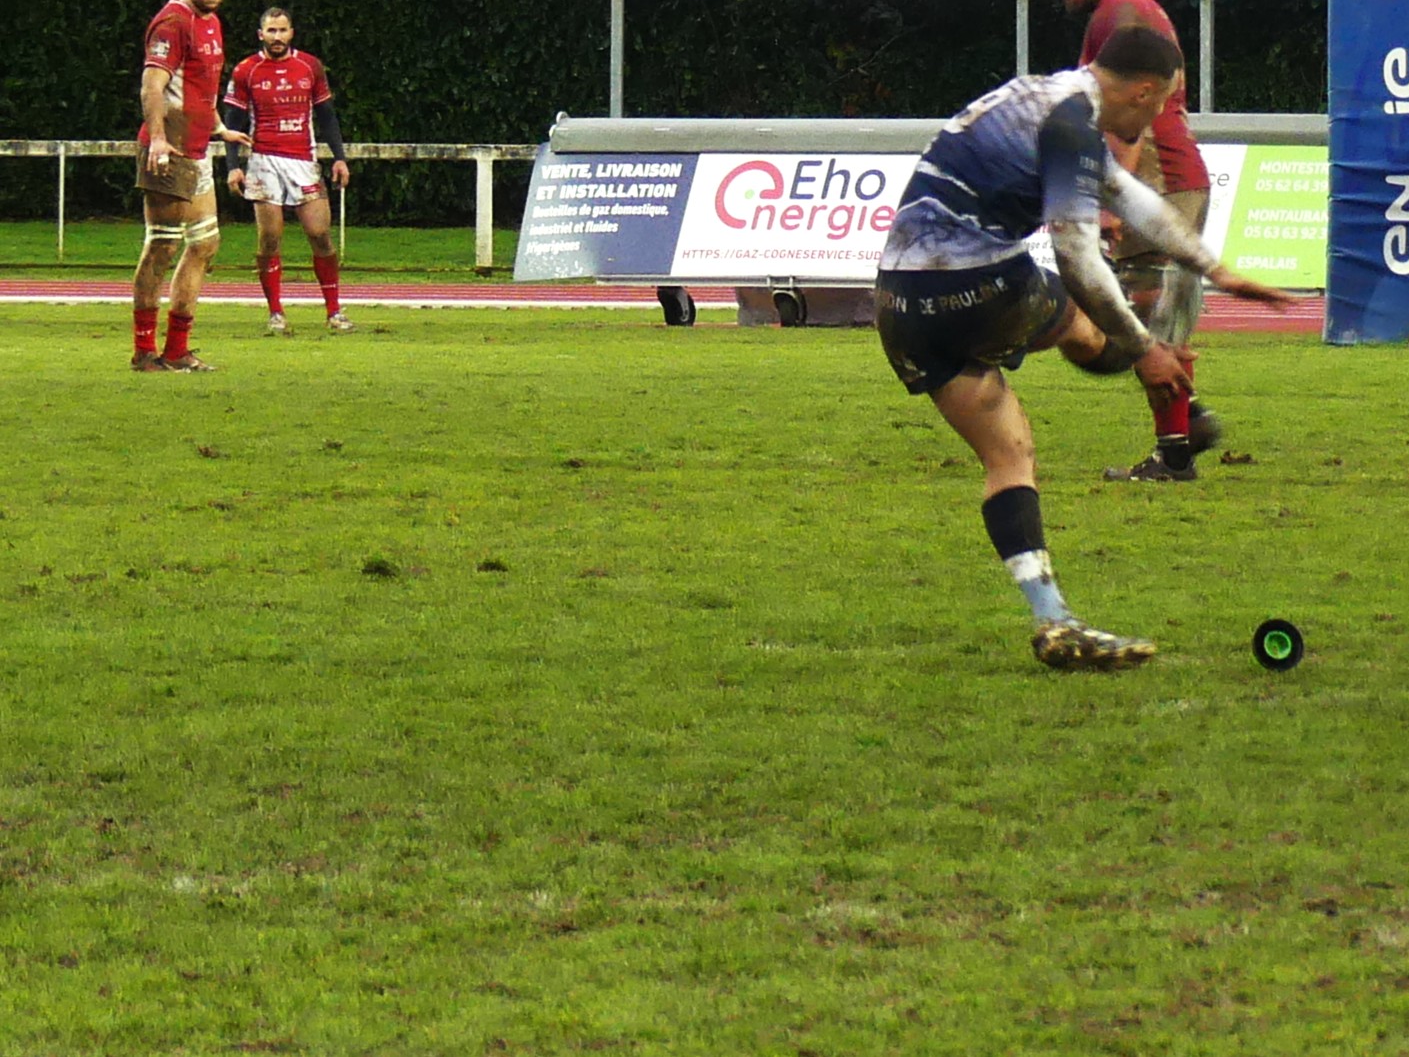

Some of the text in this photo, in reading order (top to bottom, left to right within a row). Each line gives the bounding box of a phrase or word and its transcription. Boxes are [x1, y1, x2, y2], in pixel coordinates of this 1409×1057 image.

[541, 163, 682, 179] VENTE, LIVRAISON
[789, 158, 886, 200] Eho
[1255, 179, 1272, 191] 05
[1274, 180, 1290, 191] 62
[536, 184, 677, 200] ET INSTALLATION
[579, 204, 591, 215] de
[592, 205, 609, 218] gaz
[574, 221, 584, 232] et
[1244, 226, 1260, 238] 05
[1263, 226, 1279, 239] 63
[1281, 227, 1298, 239] 63
[1300, 227, 1317, 239] 92
[1236, 256, 1297, 270] ESPALAIS
